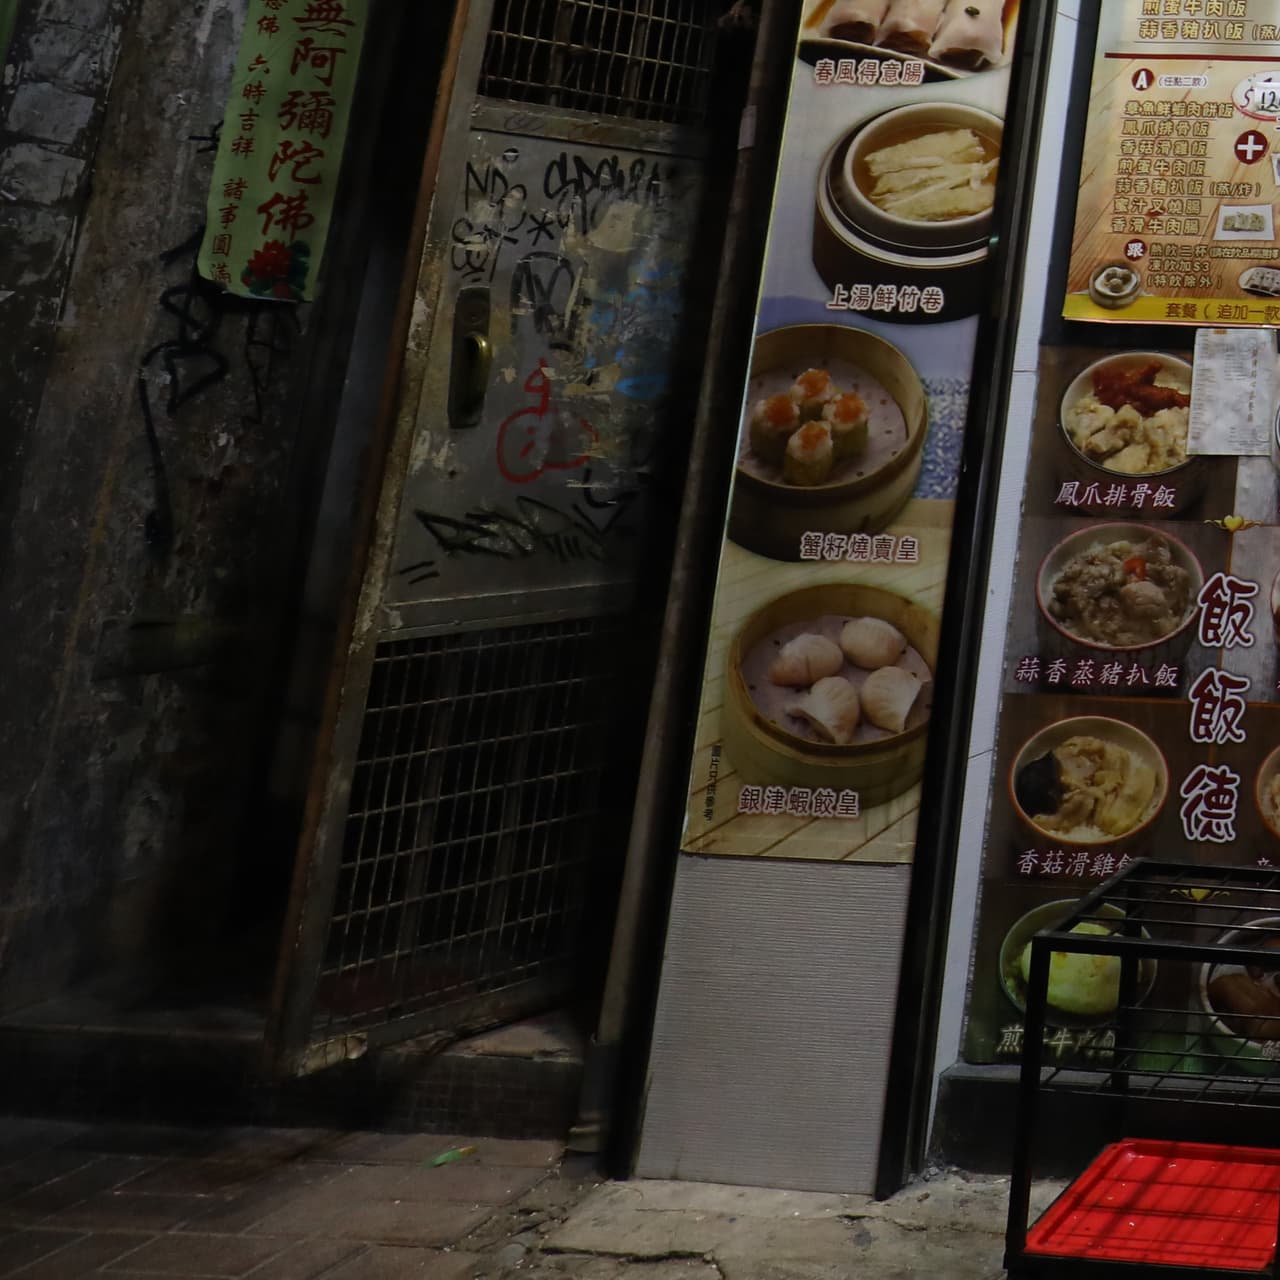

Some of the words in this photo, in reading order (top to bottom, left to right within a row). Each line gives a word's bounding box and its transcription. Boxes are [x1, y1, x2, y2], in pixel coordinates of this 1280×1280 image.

[813, 58, 925, 85] 春風得意腸
[1136, 70, 1150, 89] A
[230, 52, 269, 158] 六時吉祥
[1124, 100, 1234, 118] 章魚鮮蝦肉餅飯
[1121, 121, 1210, 137] 鳳爪排骨飯
[1119, 140, 1209, 157] 香菇滑雞飯
[1117, 160, 1207, 176] 煎蛋牛肉飯
[1113, 198, 1202, 215] 蜜汁叉燒腸
[1111, 217, 1201, 235] 香滑牛肉腸
[825, 283, 945, 312] 上湯鮮竹卷
[1052, 480, 1178, 511] 鳳爪排骨飯
[800, 532, 920, 563] 蟹籽燒賣皇
[1014, 655, 1180, 690] 蒜香蒸豬扒飯
[738, 786, 860, 818] 銀津蝦餃皇
